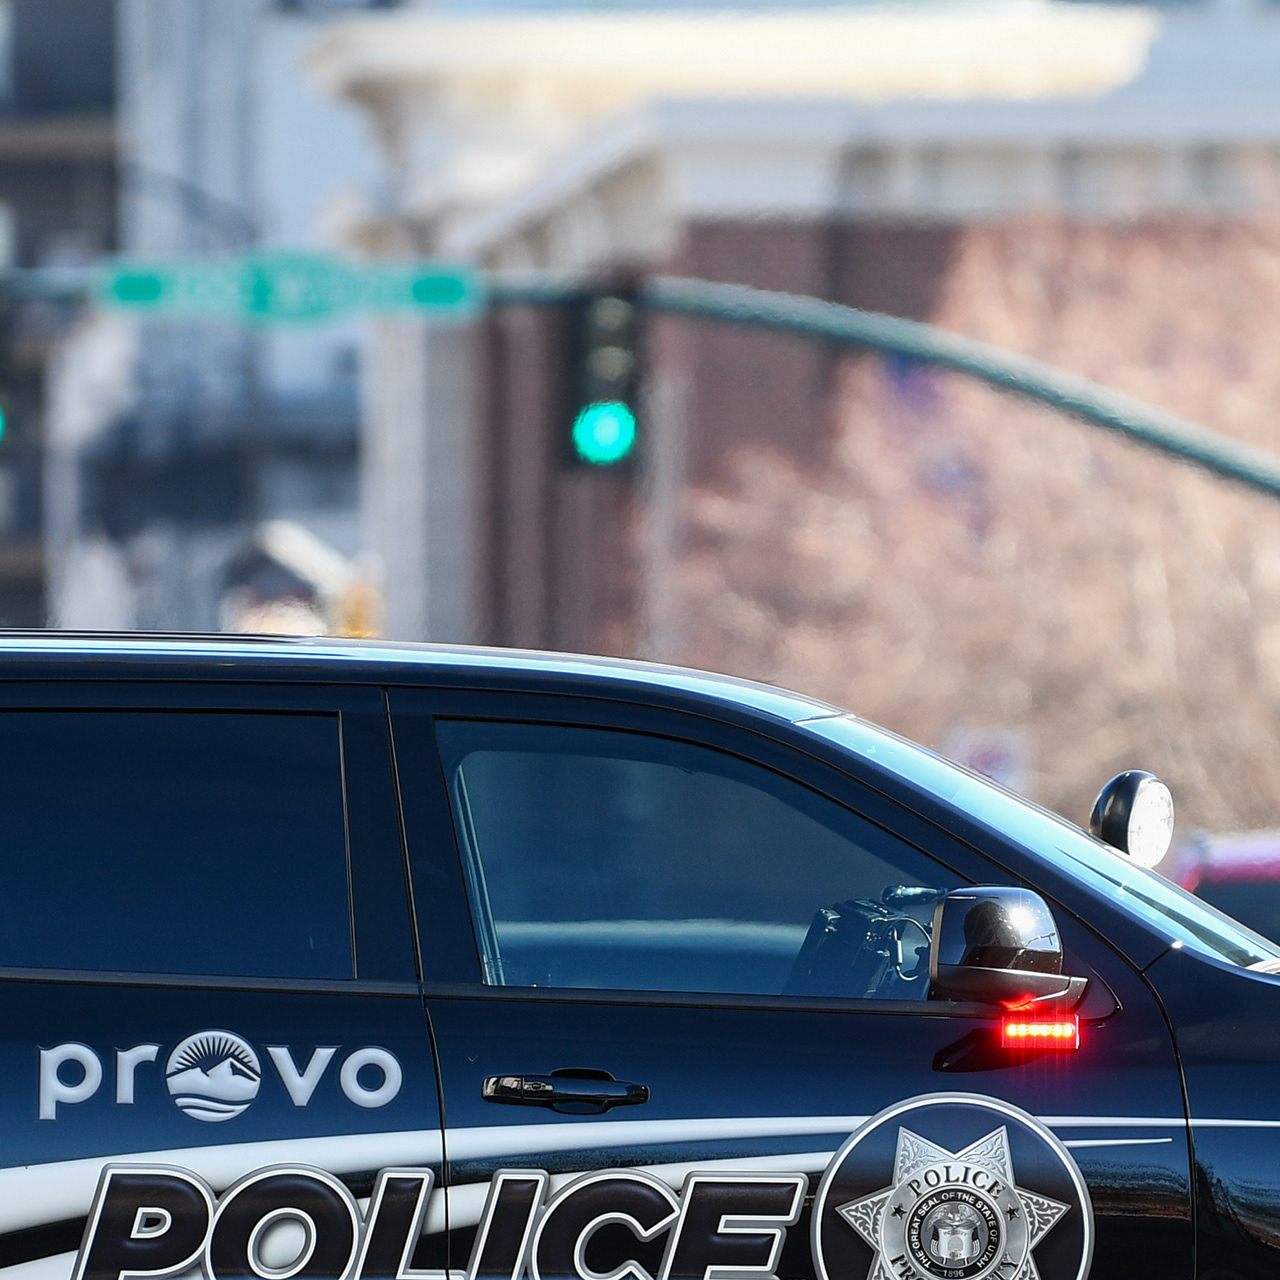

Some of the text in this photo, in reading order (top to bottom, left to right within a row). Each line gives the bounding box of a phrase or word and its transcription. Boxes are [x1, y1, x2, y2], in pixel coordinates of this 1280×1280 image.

[39, 1029, 404, 1122] provo
[907, 1165, 1006, 1200] POLICE
[918, 1195, 940, 1217] SEAL
[941, 1191, 956, 1201] OF
[957, 1191, 977, 1204] THE
[975, 1200, 997, 1228] STATE
[911, 1216, 922, 1249] GREAT
[915, 1249, 932, 1268] THE
[976, 1244, 997, 1269] UTAH
[942, 1269, 965, 1278] 1896
